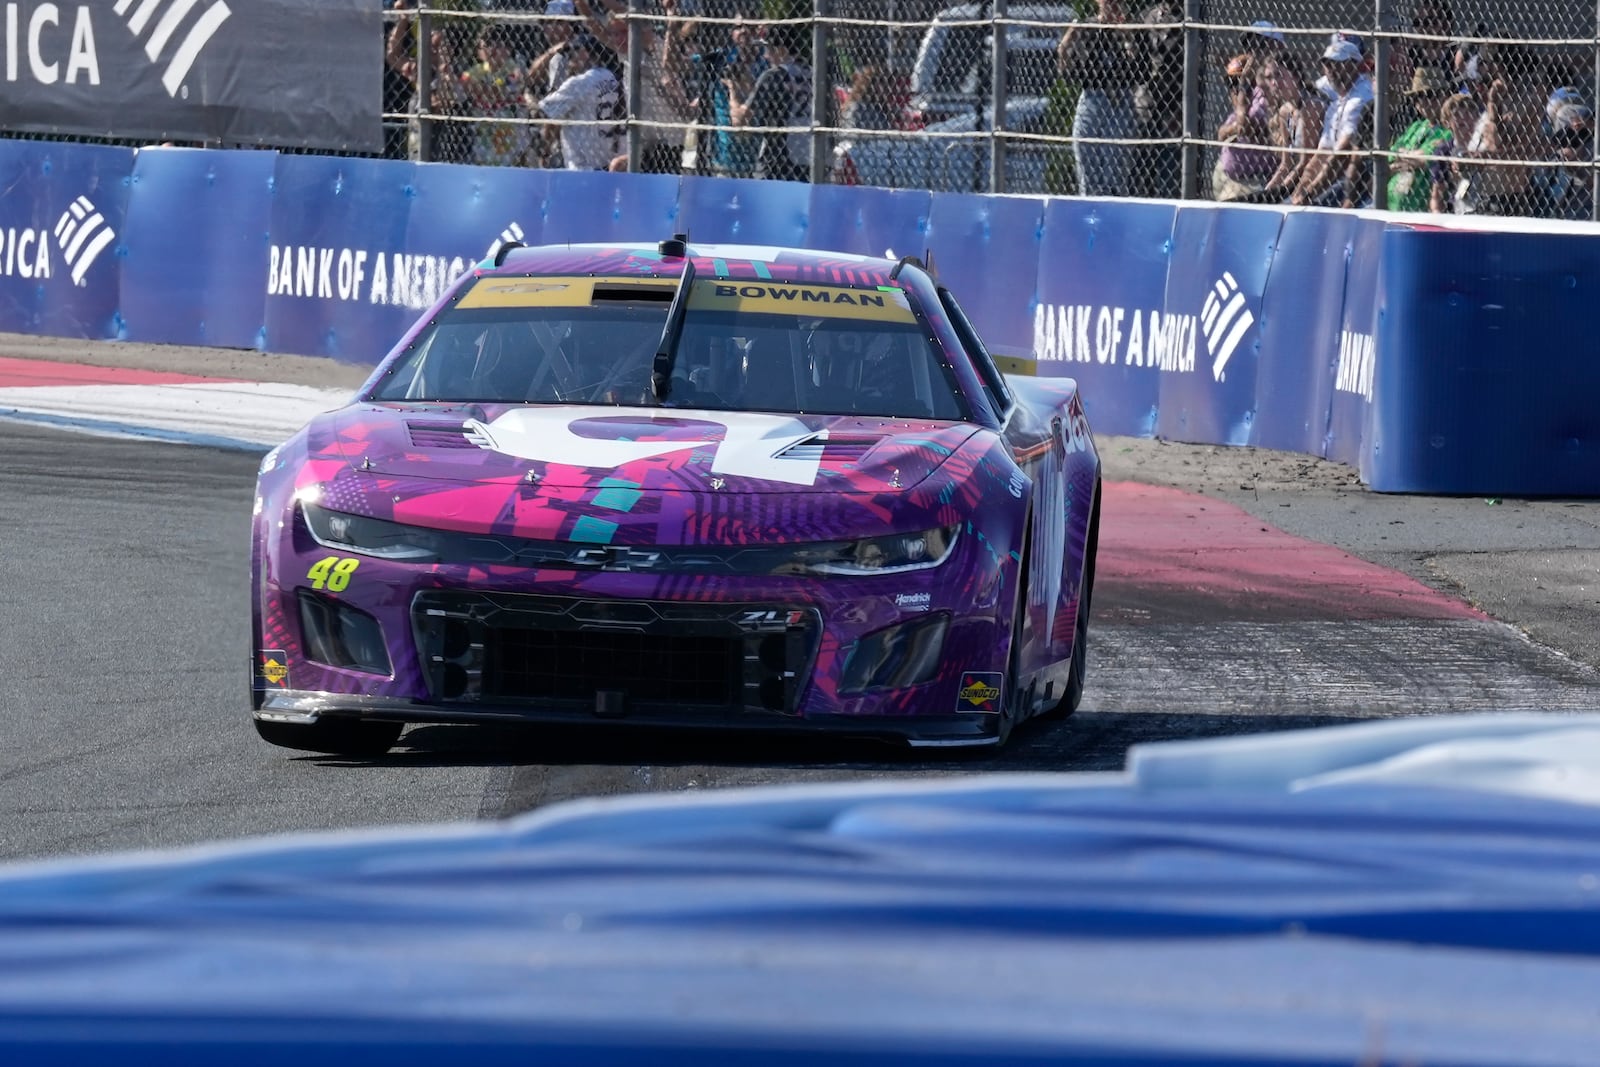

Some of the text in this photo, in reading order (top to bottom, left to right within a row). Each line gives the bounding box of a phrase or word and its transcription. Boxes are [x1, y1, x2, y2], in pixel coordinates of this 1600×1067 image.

[6, 2, 100, 85] ICA
[268, 245, 476, 310] BANK OF AMERIC
[715, 284, 885, 307] BOWMAN
[1033, 303, 1092, 363] BANK
[1096, 305, 1125, 365] OF
[1335, 330, 1372, 397] BANK
[306, 556, 360, 592] 48
[742, 610, 804, 624] ZL1
[895, 593, 931, 606] Hendrick
[962, 687, 998, 699] SUNOCO
